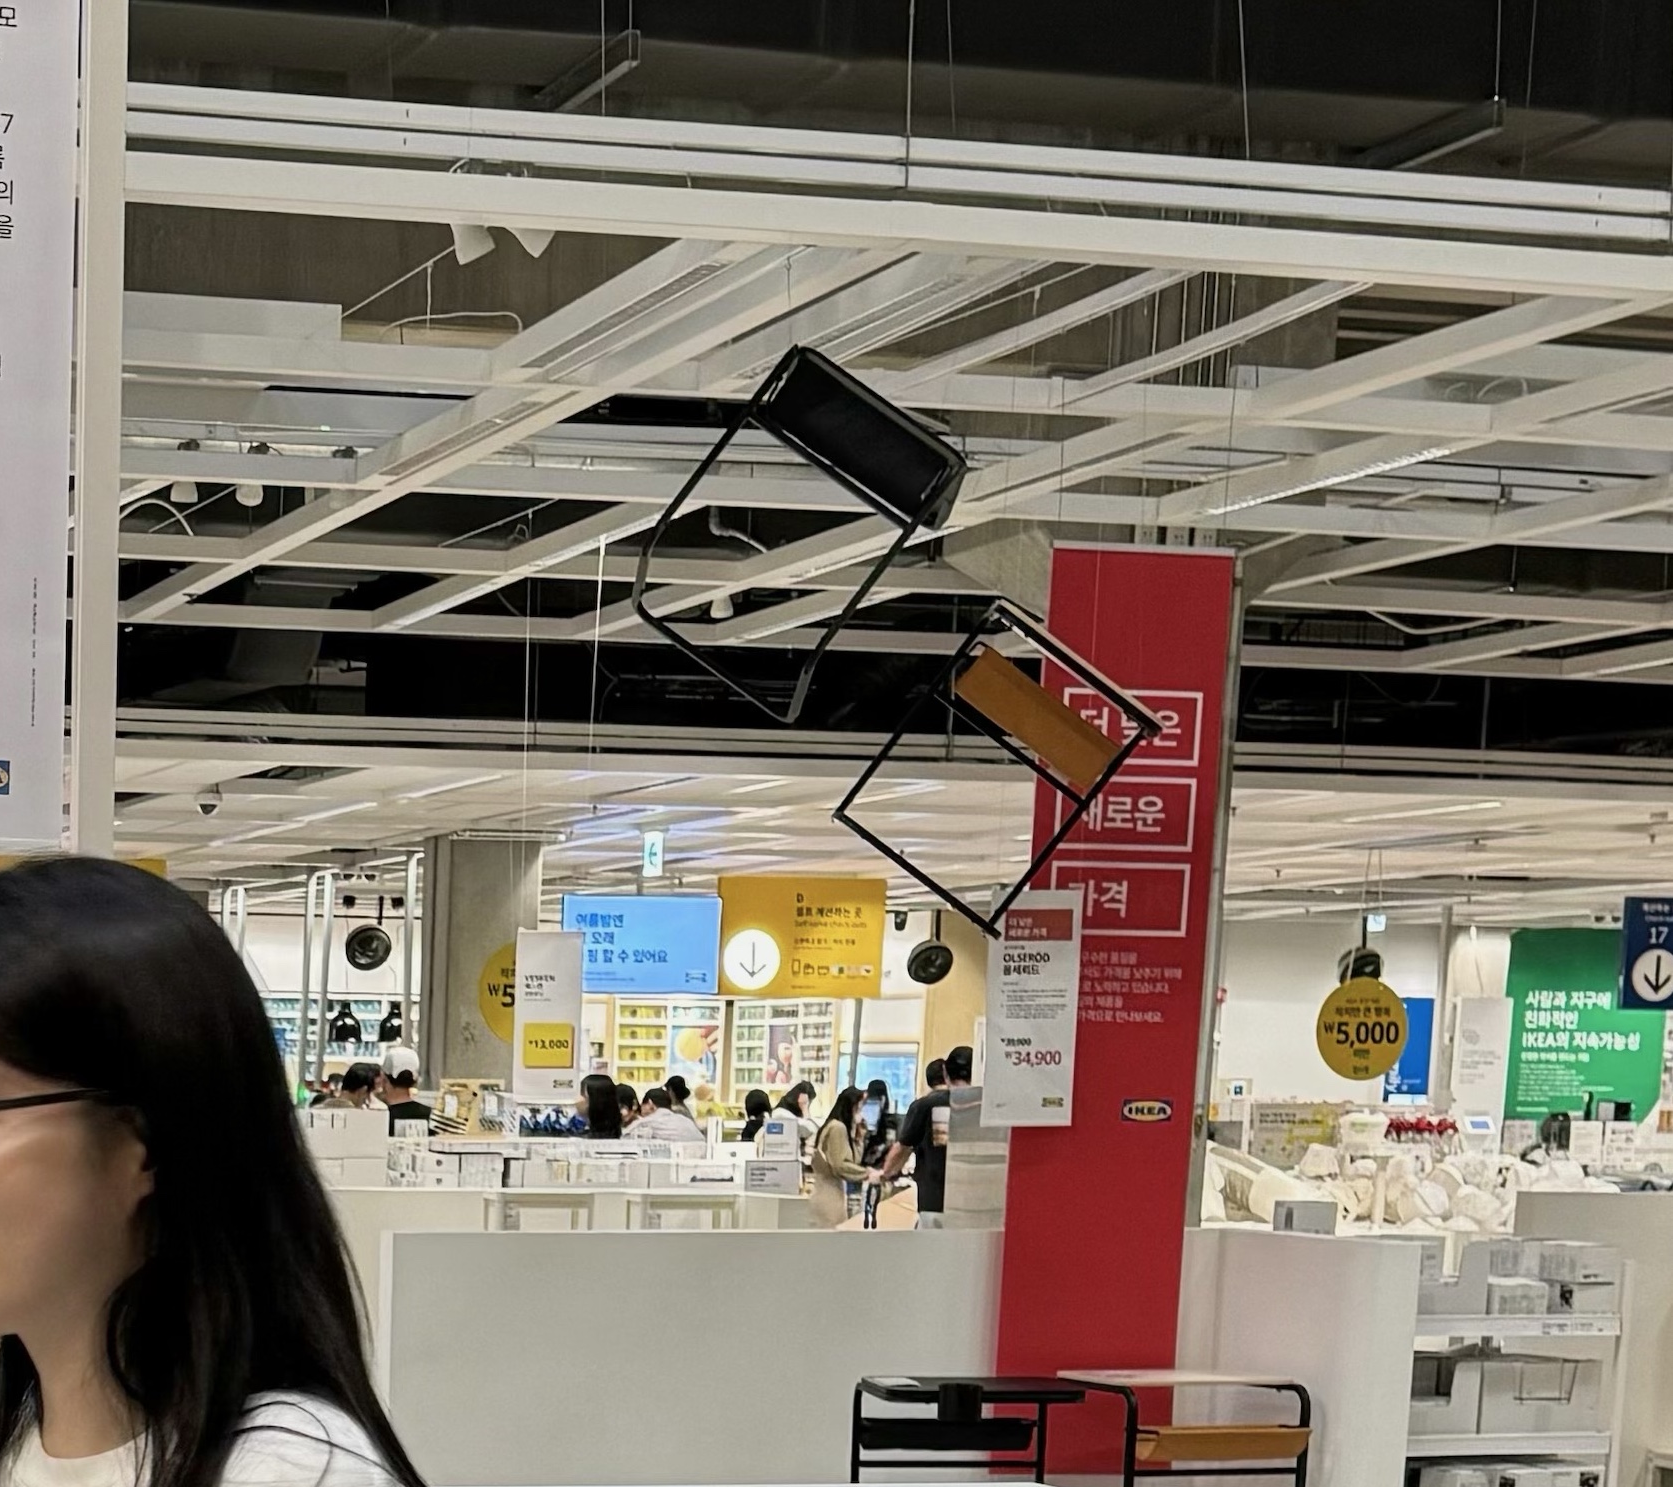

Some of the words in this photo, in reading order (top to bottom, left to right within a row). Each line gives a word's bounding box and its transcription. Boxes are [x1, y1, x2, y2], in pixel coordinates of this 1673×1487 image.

[591, 931, 615, 945] 오래
[1649, 926, 1669, 944] 17
[617, 950, 629, 963] 수
[633, 949, 669, 964] 있어요
[1525, 989, 1567, 1009] 사람과
[1570, 991, 1612, 1010] 지구에
[1324, 1020, 1399, 1049] ₩5,000
[1521, 1030, 1570, 1050] IKEA의
[1572, 1031, 1641, 1051] 지속가능성
